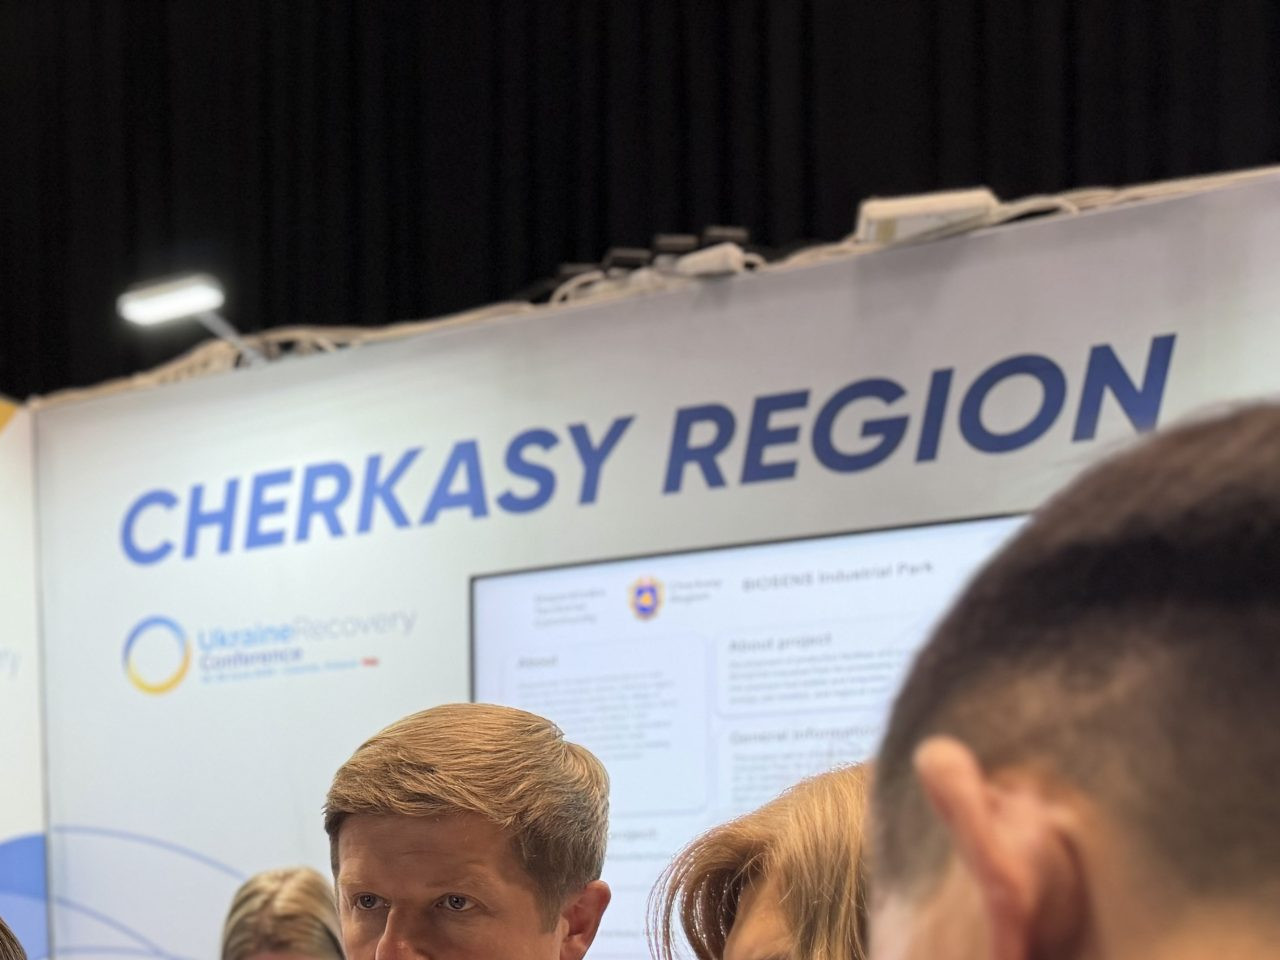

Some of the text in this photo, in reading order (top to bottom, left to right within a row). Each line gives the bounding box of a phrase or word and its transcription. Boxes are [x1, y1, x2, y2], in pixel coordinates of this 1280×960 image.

[119, 333, 1177, 566] CHERKASY REGION
[817, 563, 893, 585] Industrial
[896, 559, 934, 578] Park
